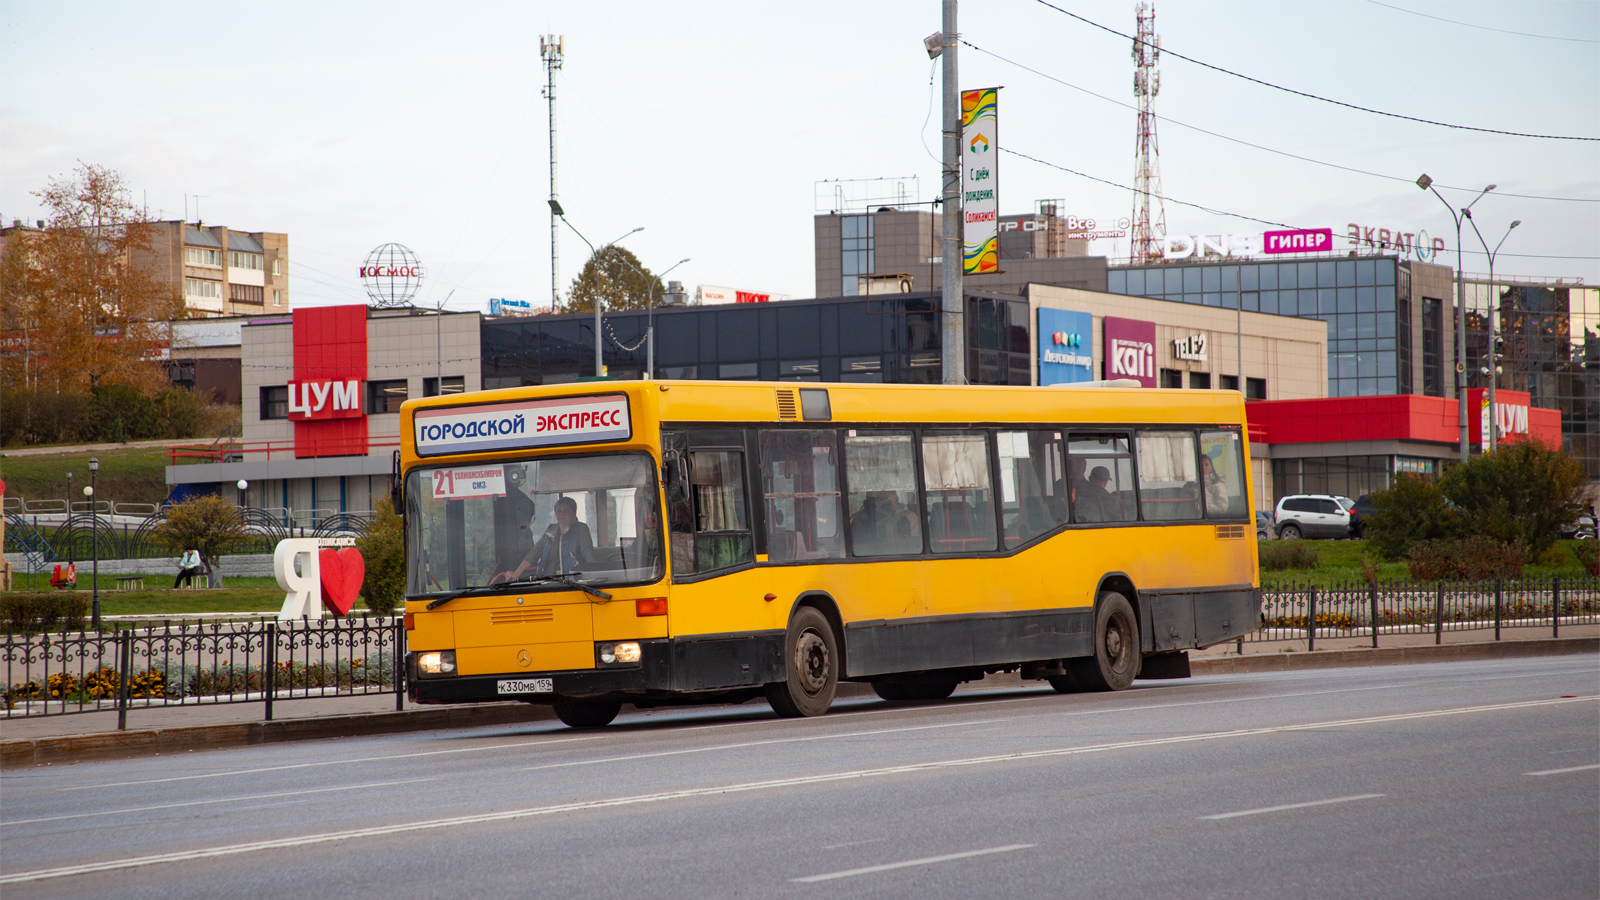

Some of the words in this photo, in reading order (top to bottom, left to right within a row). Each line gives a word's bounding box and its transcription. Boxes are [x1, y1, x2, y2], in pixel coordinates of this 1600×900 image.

[975, 167, 990, 182] днём
[965, 189, 995, 204] рождения,
[965, 209, 996, 224] Соликамск!
[1067, 215, 1096, 230] Все
[1067, 230, 1126, 241] инструменты
[1164, 233, 1260, 259] DNS
[1270, 233, 1326, 249] ГИПЕР
[1347, 223, 1445, 263] ЭКВАТОР
[359, 266, 419, 278] КОСМОС
[1111, 338, 1154, 378] kari
[1174, 333, 1208, 361] TELE2
[1043, 349, 1076, 365] Детский
[1076, 355, 1092, 371] мир
[288, 380, 359, 417] ЦУМ
[420, 414, 525, 442] ГОРОДСКОЙ
[536, 409, 621, 433] ЭКСПРЕСС
[1495, 402, 1529, 438] ЦУМ
[433, 469, 455, 496] 21
[472, 480, 487, 490] СМЗ
[273, 538, 322, 621] Я
[500, 681, 535, 692] К330МВ
[537, 679, 550, 688] 159
